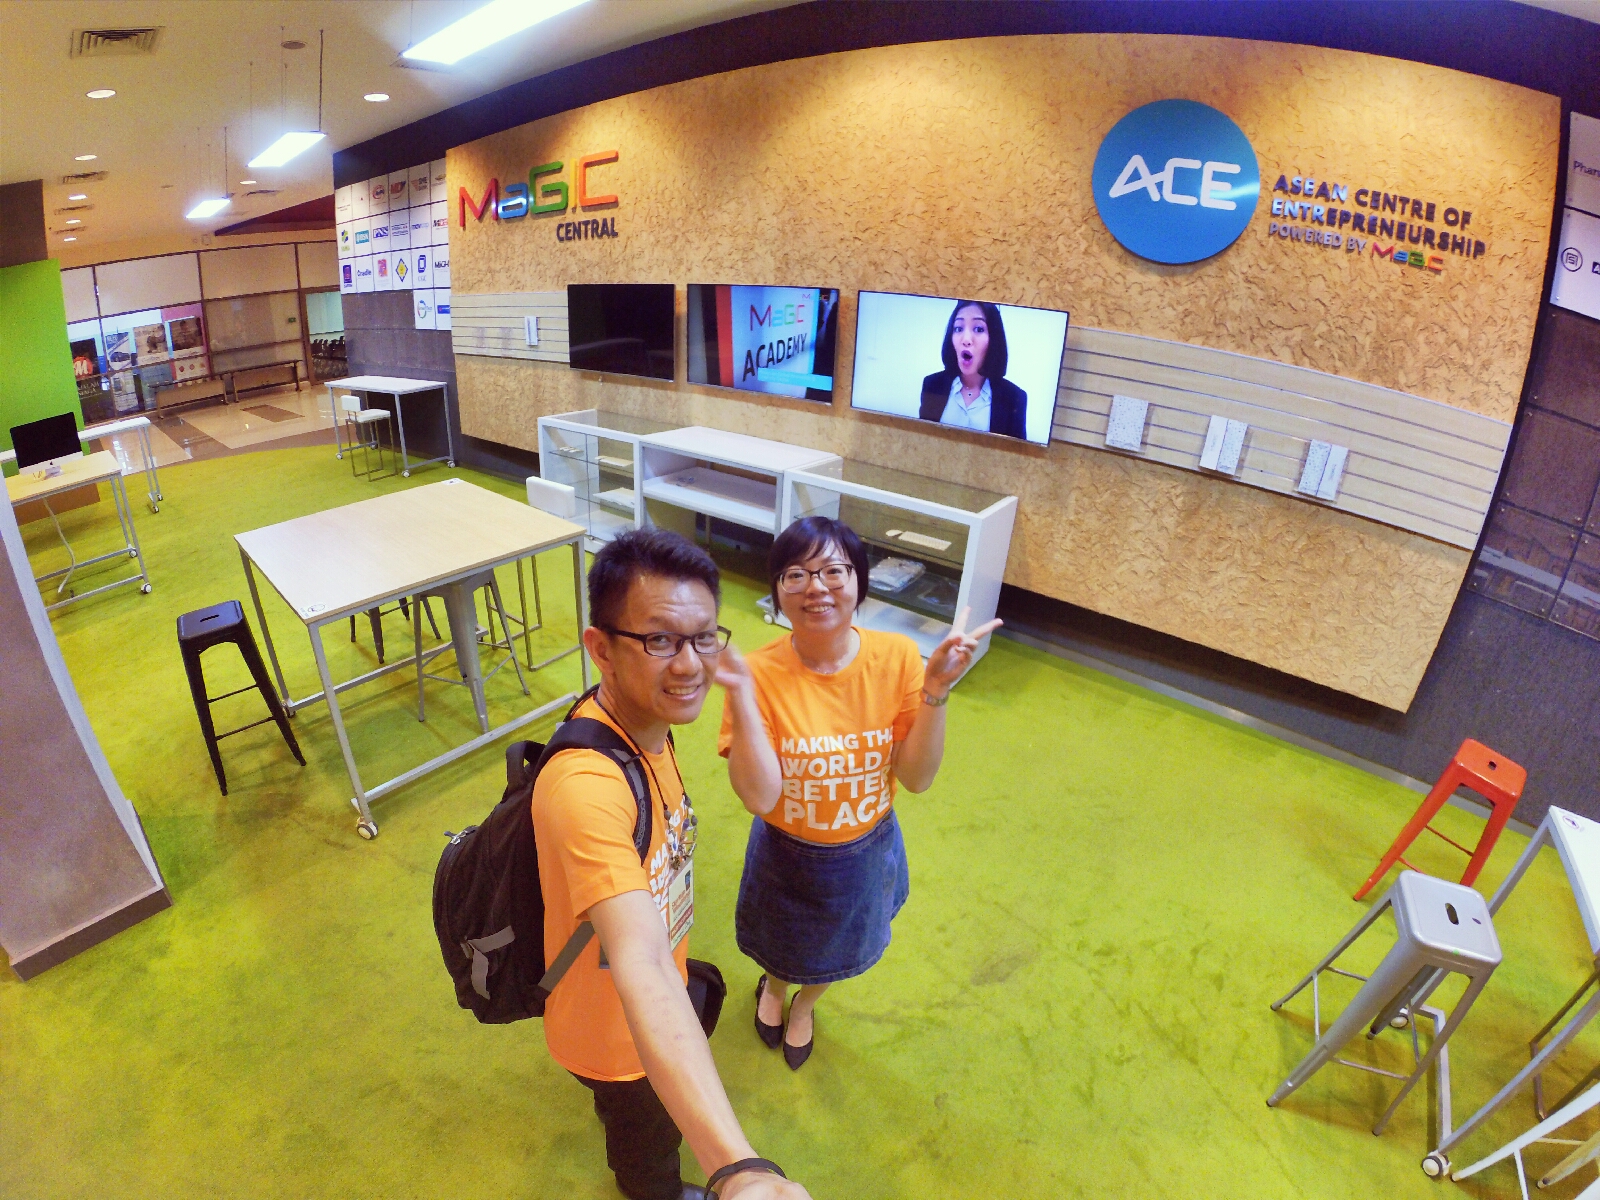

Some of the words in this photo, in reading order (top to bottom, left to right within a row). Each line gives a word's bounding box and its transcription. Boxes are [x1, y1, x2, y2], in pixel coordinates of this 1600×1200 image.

[1109, 155, 1241, 211] ACE
[1273, 174, 1348, 203] ASEAN
[1355, 188, 1436, 223] CENTRE
[1444, 207, 1473, 230] OF
[556, 217, 618, 242] CENTRAL
[1269, 222, 1343, 248] POWERED
[1347, 236, 1367, 254] BY
[1271, 197, 1486, 259] ENTREPRENEURSHIP
[743, 333, 808, 382] ACADEMY
[781, 734, 859, 755] MAKING
[781, 751, 883, 778] WORLD
[785, 789, 891, 830] PLACE
